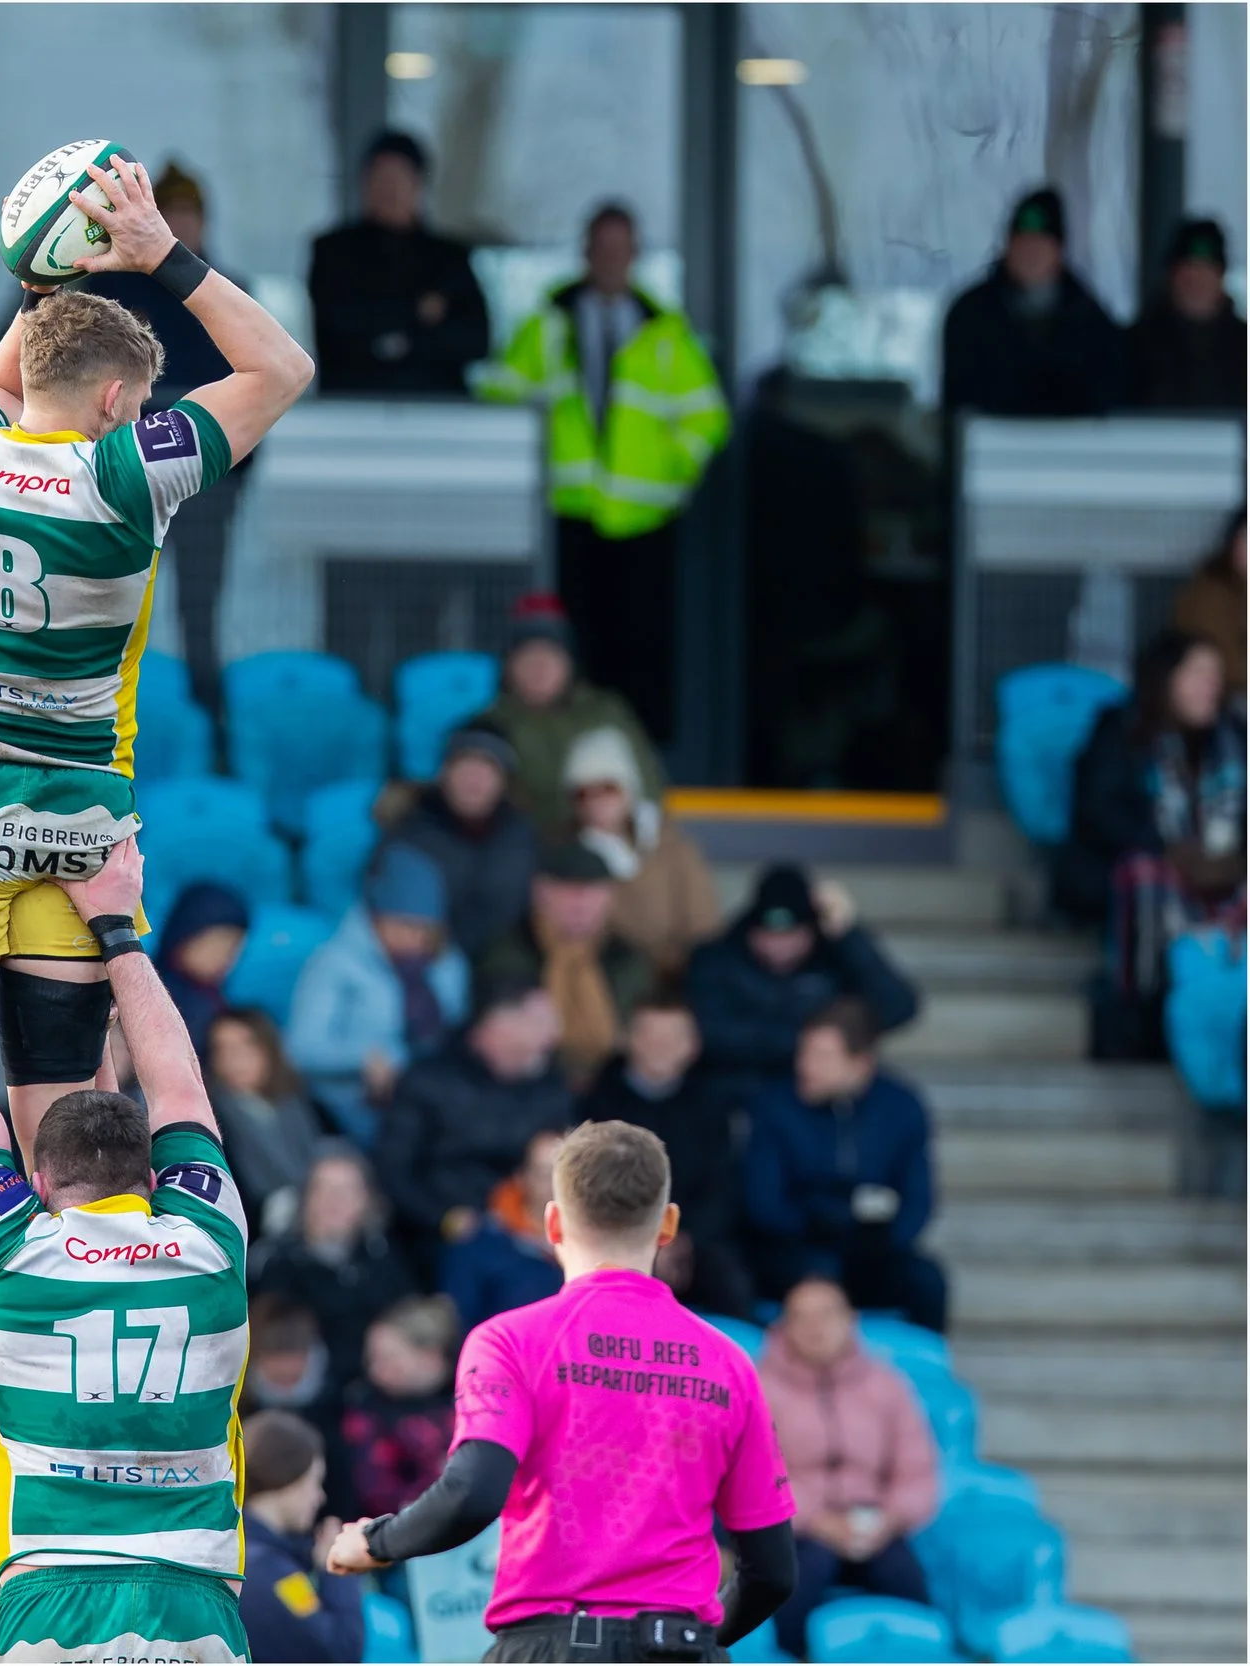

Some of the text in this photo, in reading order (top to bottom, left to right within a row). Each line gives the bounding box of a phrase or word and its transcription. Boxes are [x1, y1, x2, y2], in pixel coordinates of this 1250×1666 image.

[66, 1237, 181, 1265] Compra
[52, 1305, 190, 1403] 17
[557, 1361, 730, 1410] #BEPARTOFTHETEAM
